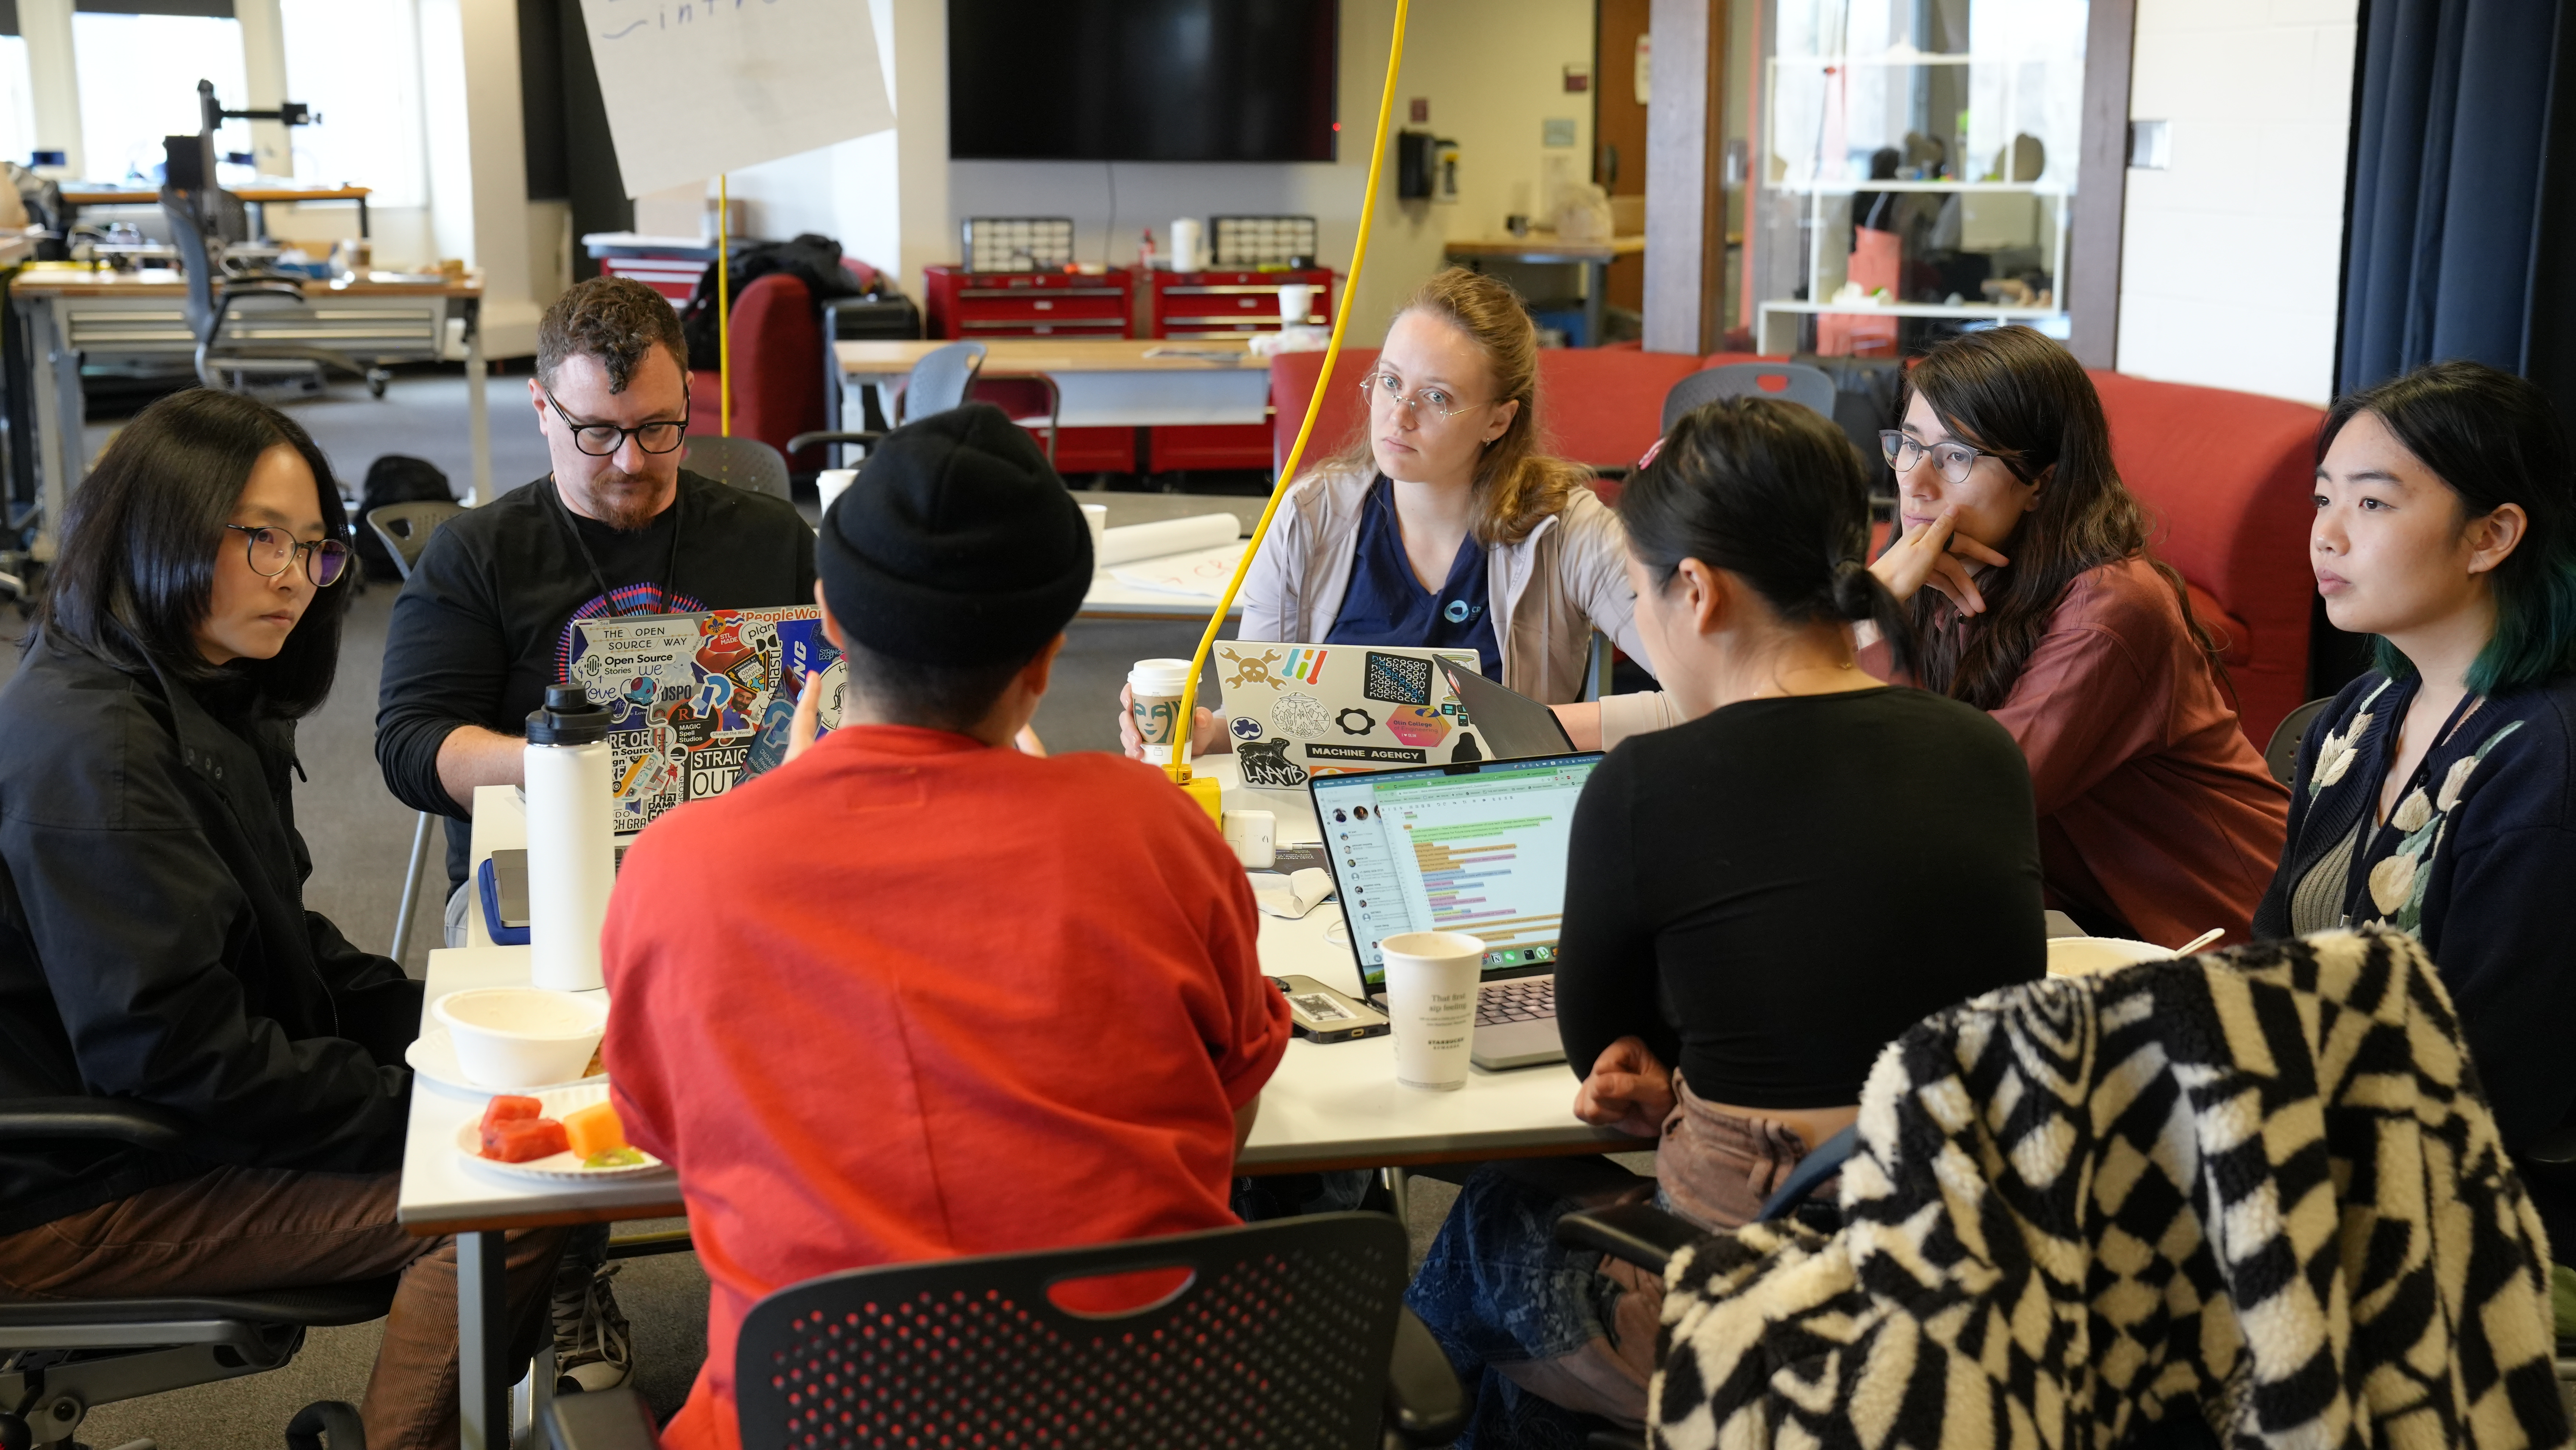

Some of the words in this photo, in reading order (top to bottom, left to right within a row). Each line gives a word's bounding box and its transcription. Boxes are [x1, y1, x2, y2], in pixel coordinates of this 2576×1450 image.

[604, 630, 623, 638] THE
[636, 627, 665, 636] OPEN
[748, 623, 775, 639] plan
[608, 640, 652, 650] SOURCE
[663, 638, 687, 646] WAY
[720, 636, 738, 645] MADE
[605, 657, 634, 667] Open
[637, 654, 673, 662] Source
[734, 659, 751, 671] POWERED
[769, 640, 782, 688] elasti
[741, 664, 757, 676] open
[743, 667, 762, 681] source
[584, 681, 617, 699] love
[662, 685, 691, 701] OSPO
[1401, 726, 1438, 734] Engineering
[1312, 747, 1366, 757] MACHINE
[1371, 750, 1419, 760] AGENCY
[653, 793, 676, 803] THAT
[1432, 994, 1450, 1002] That
[1443, 1003, 1466, 1012] feeling
